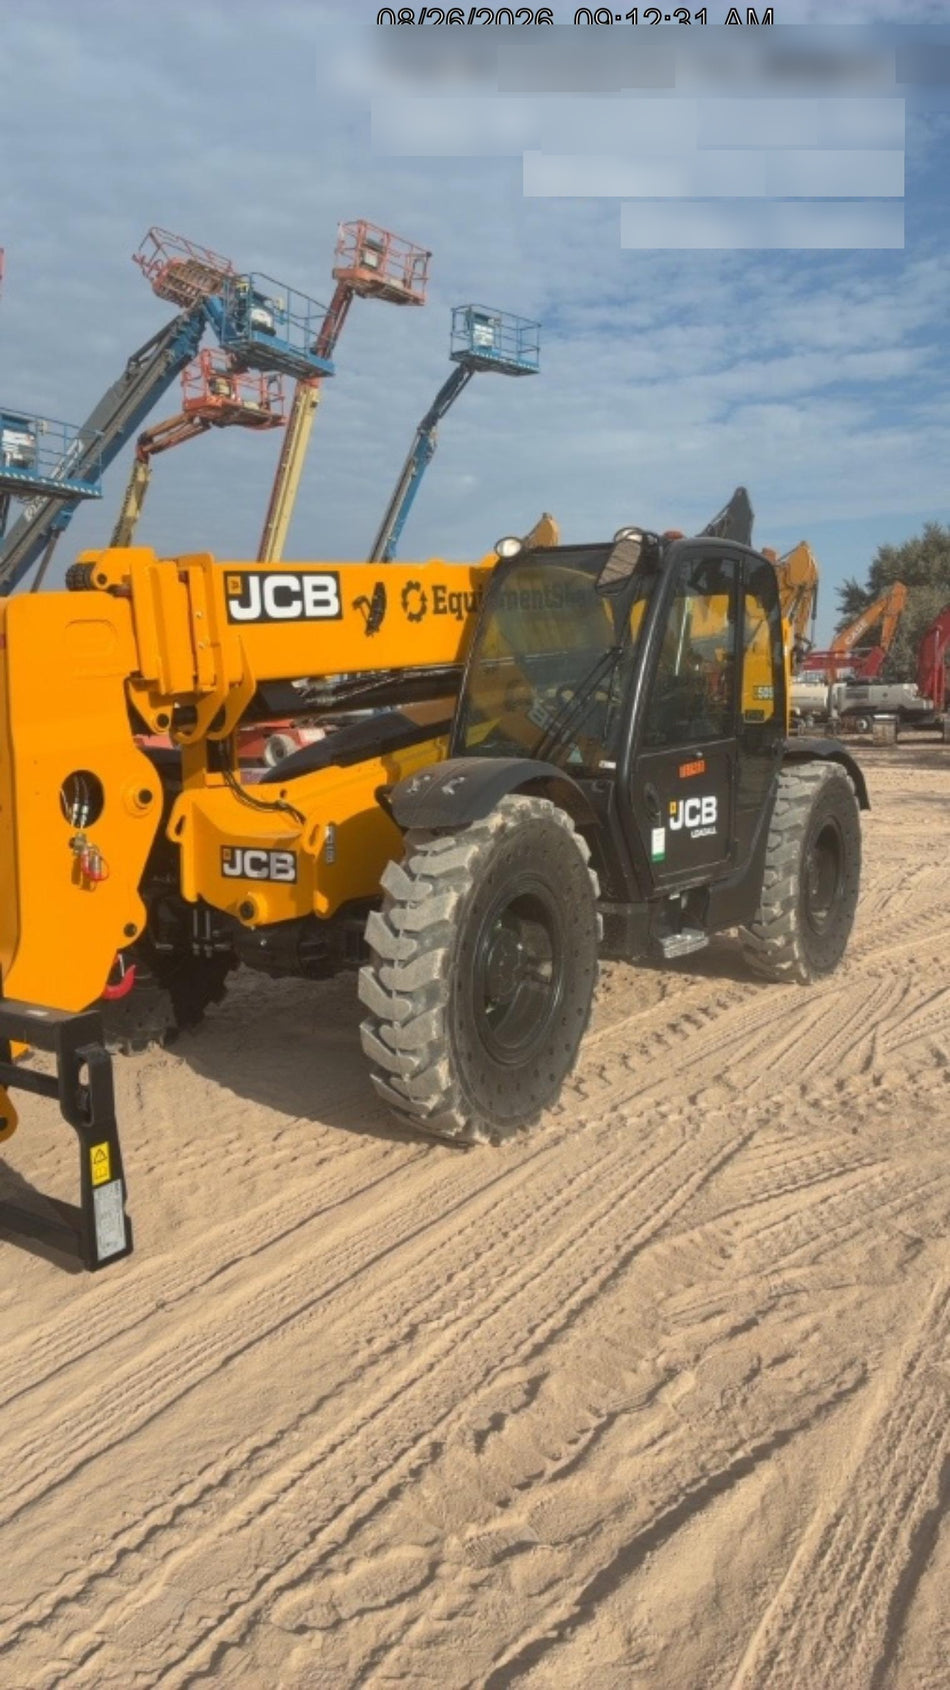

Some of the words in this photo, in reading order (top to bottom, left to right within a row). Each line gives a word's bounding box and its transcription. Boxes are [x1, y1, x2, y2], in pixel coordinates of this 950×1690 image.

[228, 574, 341, 621] JCB
[669, 796, 717, 830] JCB
[223, 849, 296, 882] JCB
